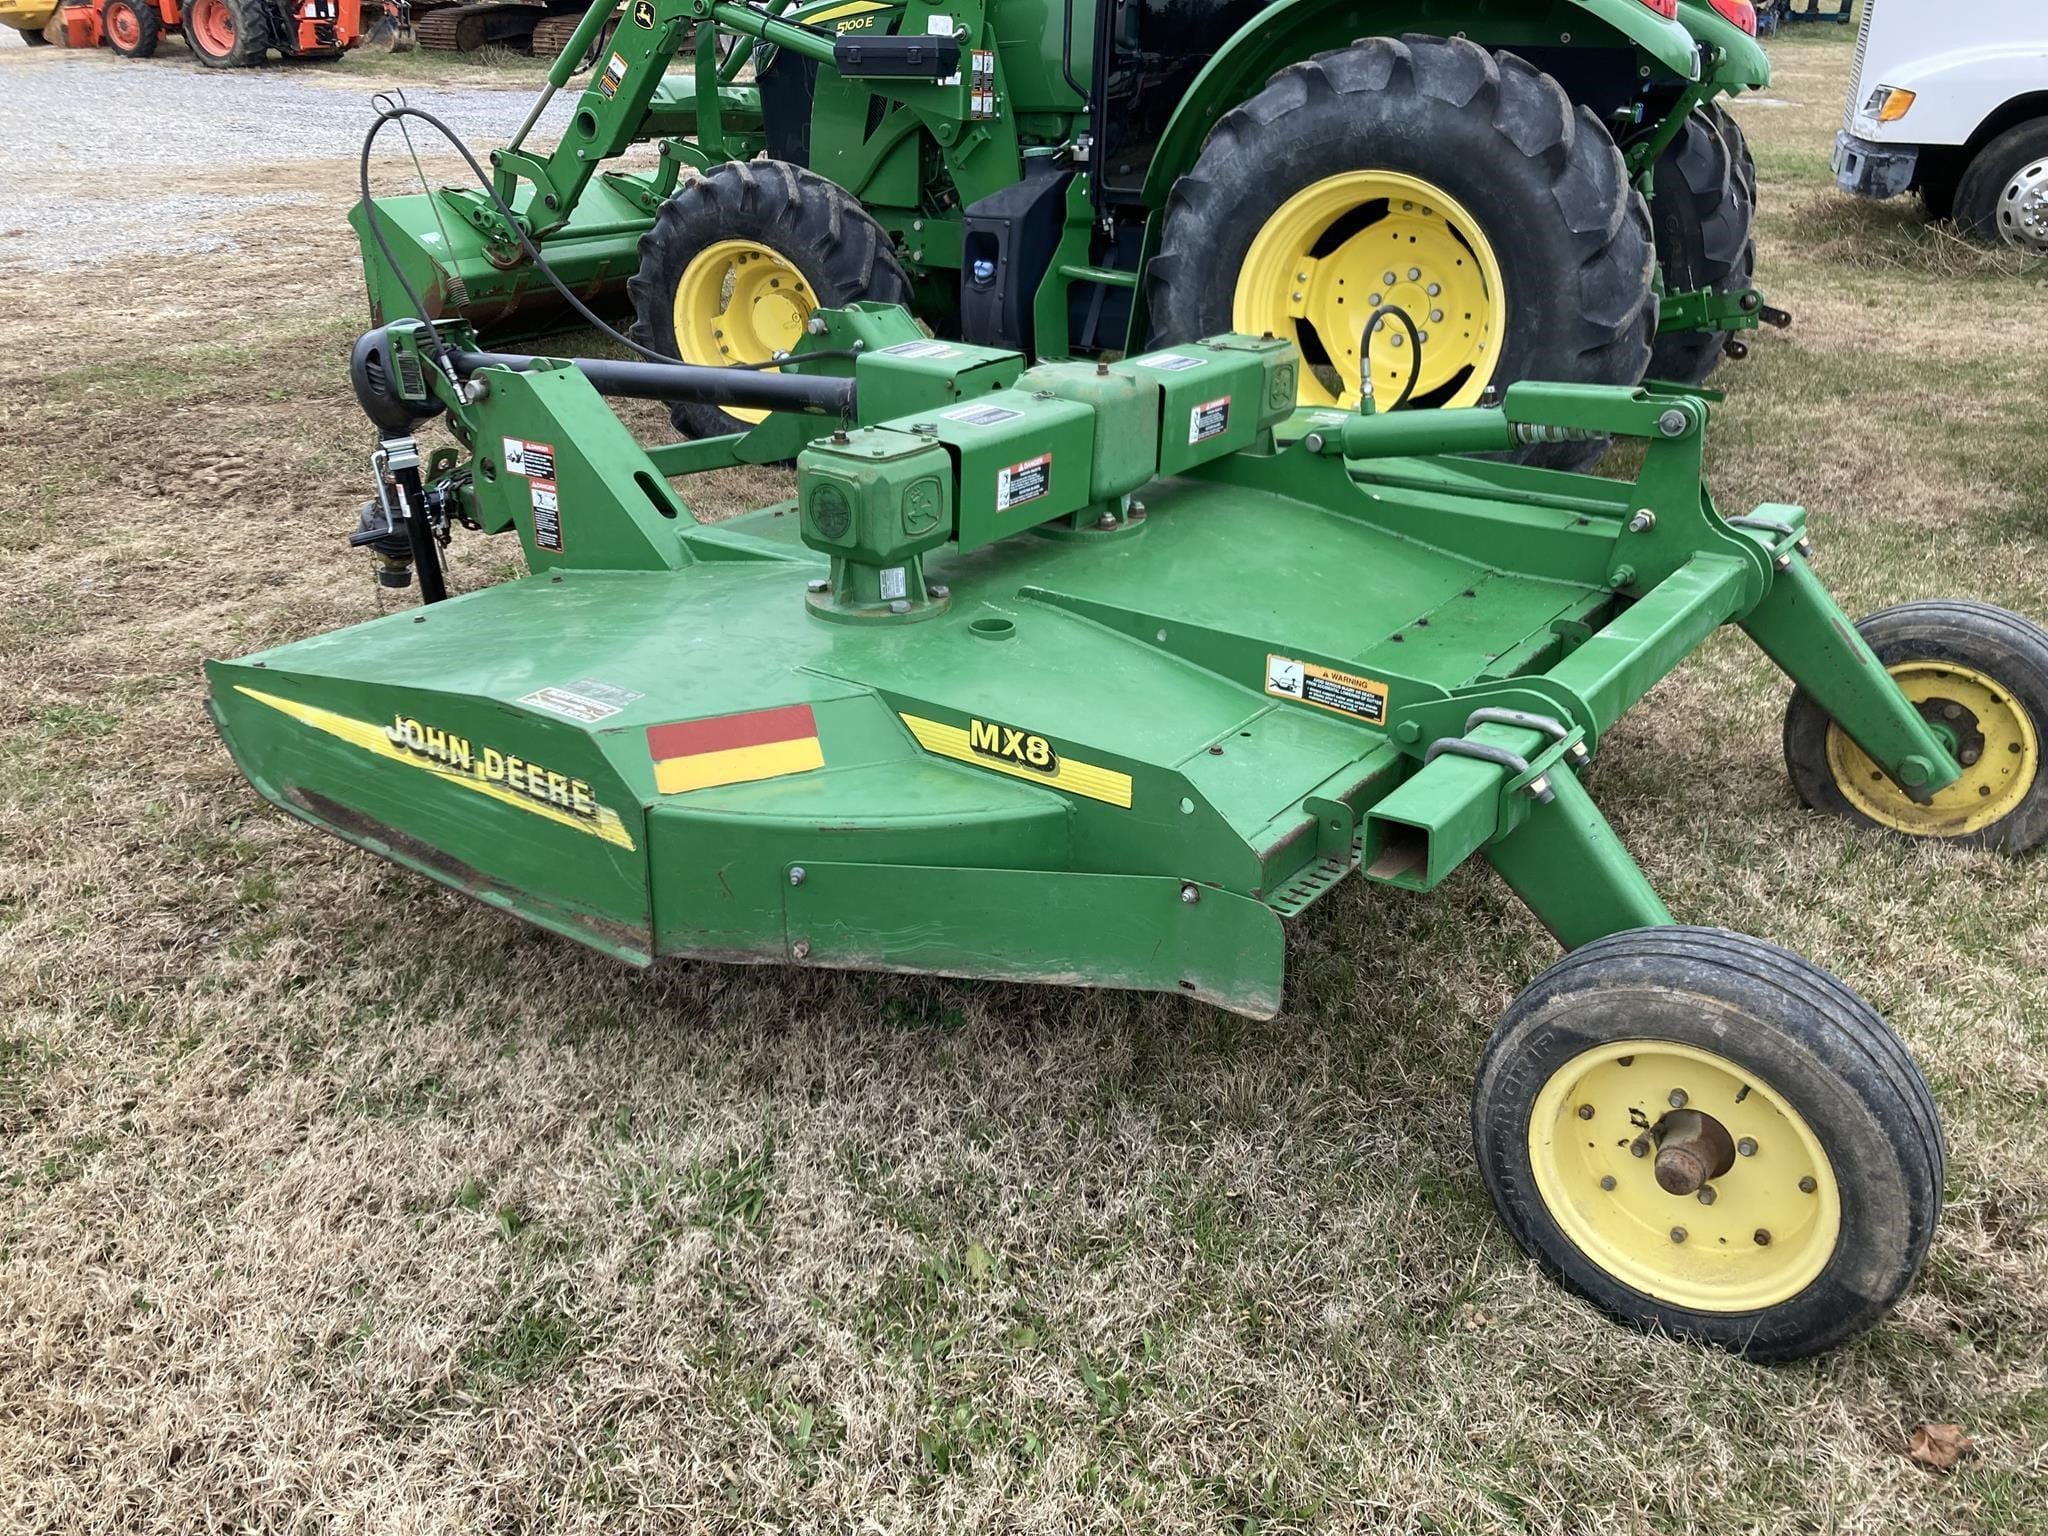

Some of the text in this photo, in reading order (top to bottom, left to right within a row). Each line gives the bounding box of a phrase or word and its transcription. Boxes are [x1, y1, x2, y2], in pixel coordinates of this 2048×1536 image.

[837, 16, 875, 35] 5100 E
[1331, 672, 1368, 689] WARNING
[970, 718, 1052, 767] MX8
[386, 714, 596, 815] JOHN DEERE
